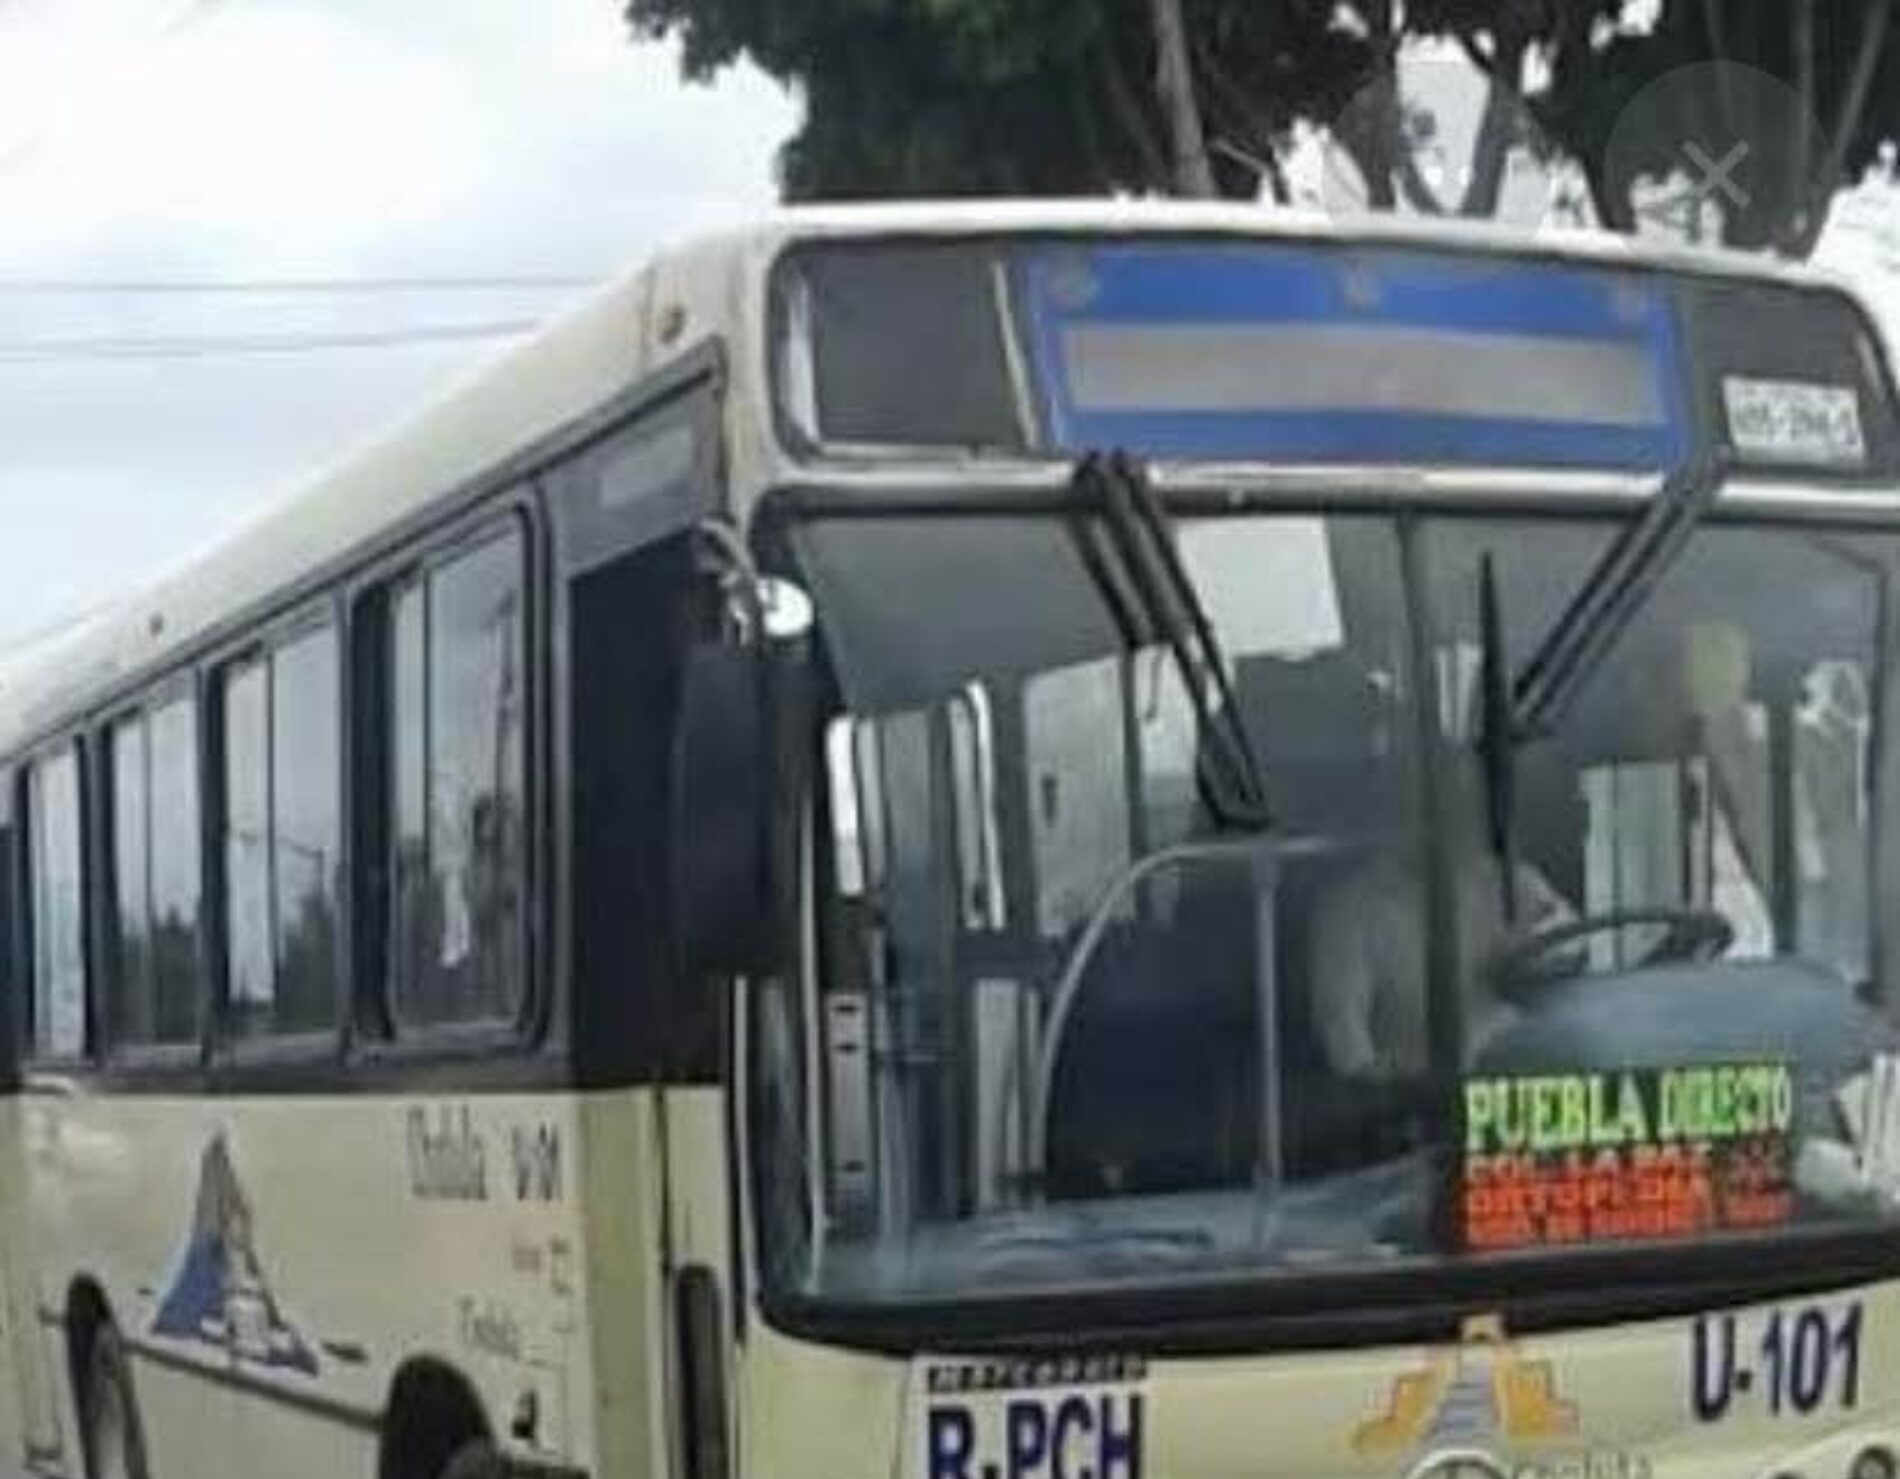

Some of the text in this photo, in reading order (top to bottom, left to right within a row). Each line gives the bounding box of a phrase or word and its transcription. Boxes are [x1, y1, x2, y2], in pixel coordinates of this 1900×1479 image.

[1465, 1065, 1792, 1150] PUEBLA DIRECTO
[1692, 1300, 1862, 1421] U-101
